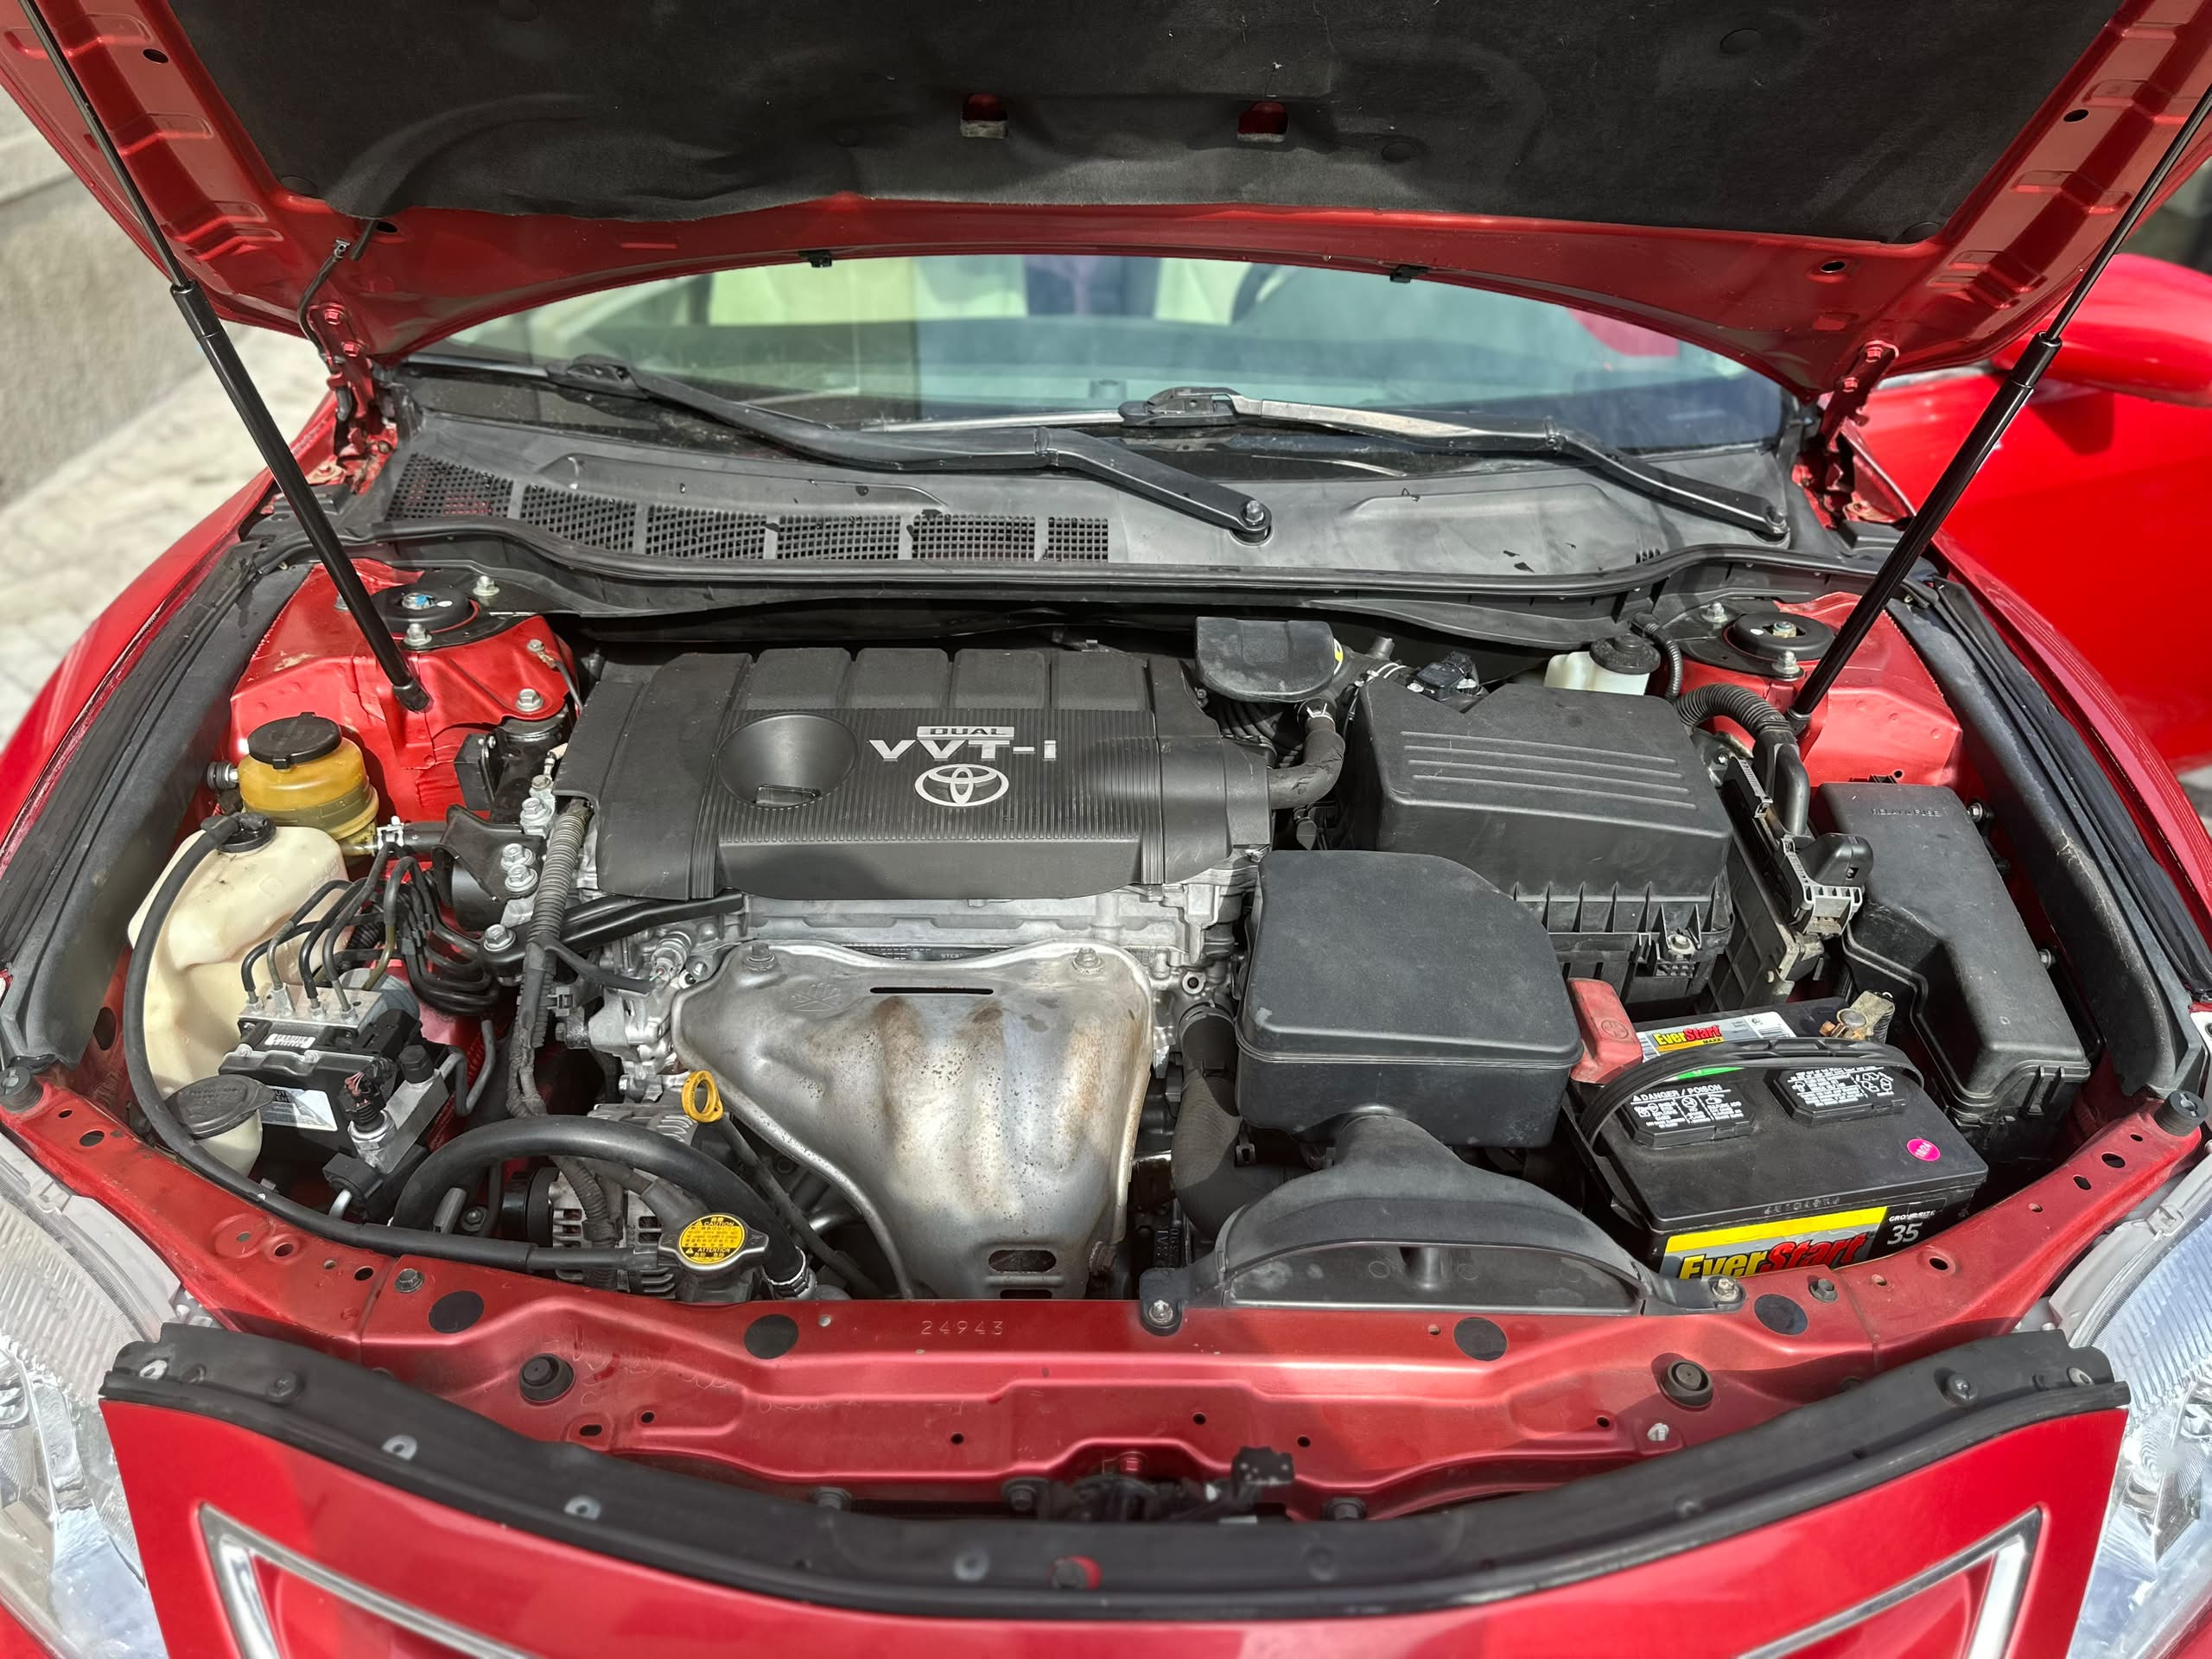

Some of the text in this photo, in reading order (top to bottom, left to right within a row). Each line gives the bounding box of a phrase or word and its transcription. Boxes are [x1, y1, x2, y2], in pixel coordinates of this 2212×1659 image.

[1652, 1025, 1723, 1046] EverStart
[1640, 1090, 1680, 1101] DANGER
[1687, 1084, 1724, 1095] POISON
[1886, 1222, 1923, 1245] 35
[1679, 1231, 1869, 1279] EverStart
[920, 1320, 1004, 1335] 24943
